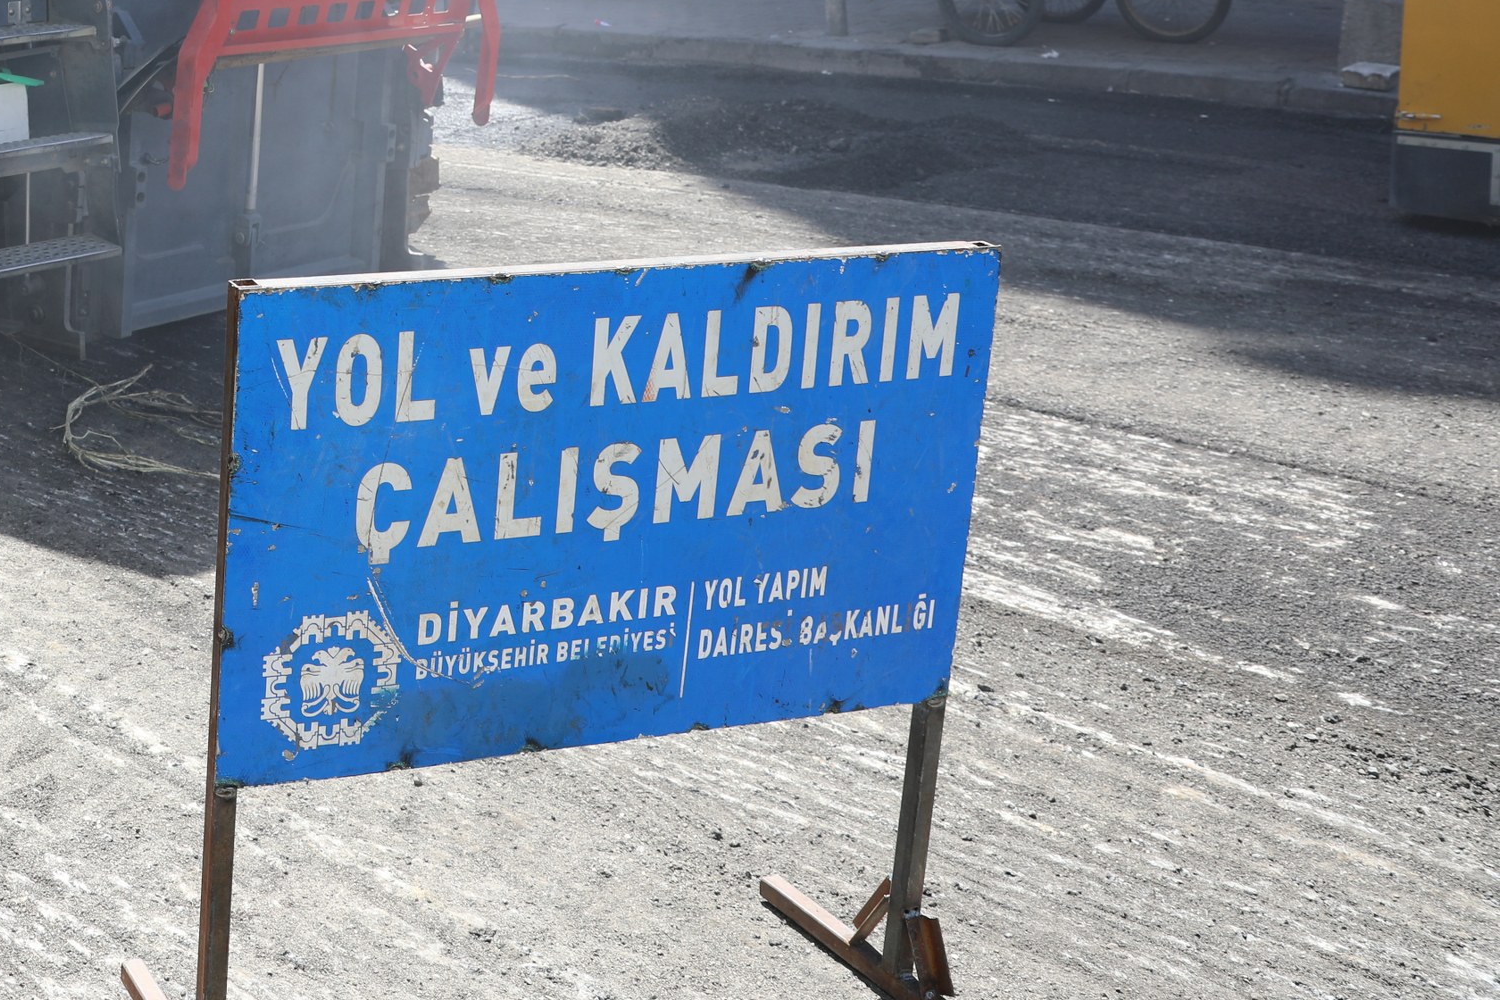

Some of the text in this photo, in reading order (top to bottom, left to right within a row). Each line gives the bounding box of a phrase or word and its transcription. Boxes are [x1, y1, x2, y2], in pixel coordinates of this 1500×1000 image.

[277, 292, 961, 430] YOL ve KALDIRIM
[355, 420, 876, 565] ÇALIŞMASI
[417, 585, 677, 646] DİYARBAKIR
[705, 565, 828, 611] YOL YAPIM
[415, 639, 549, 680] BÜYÜKŞEHİR
